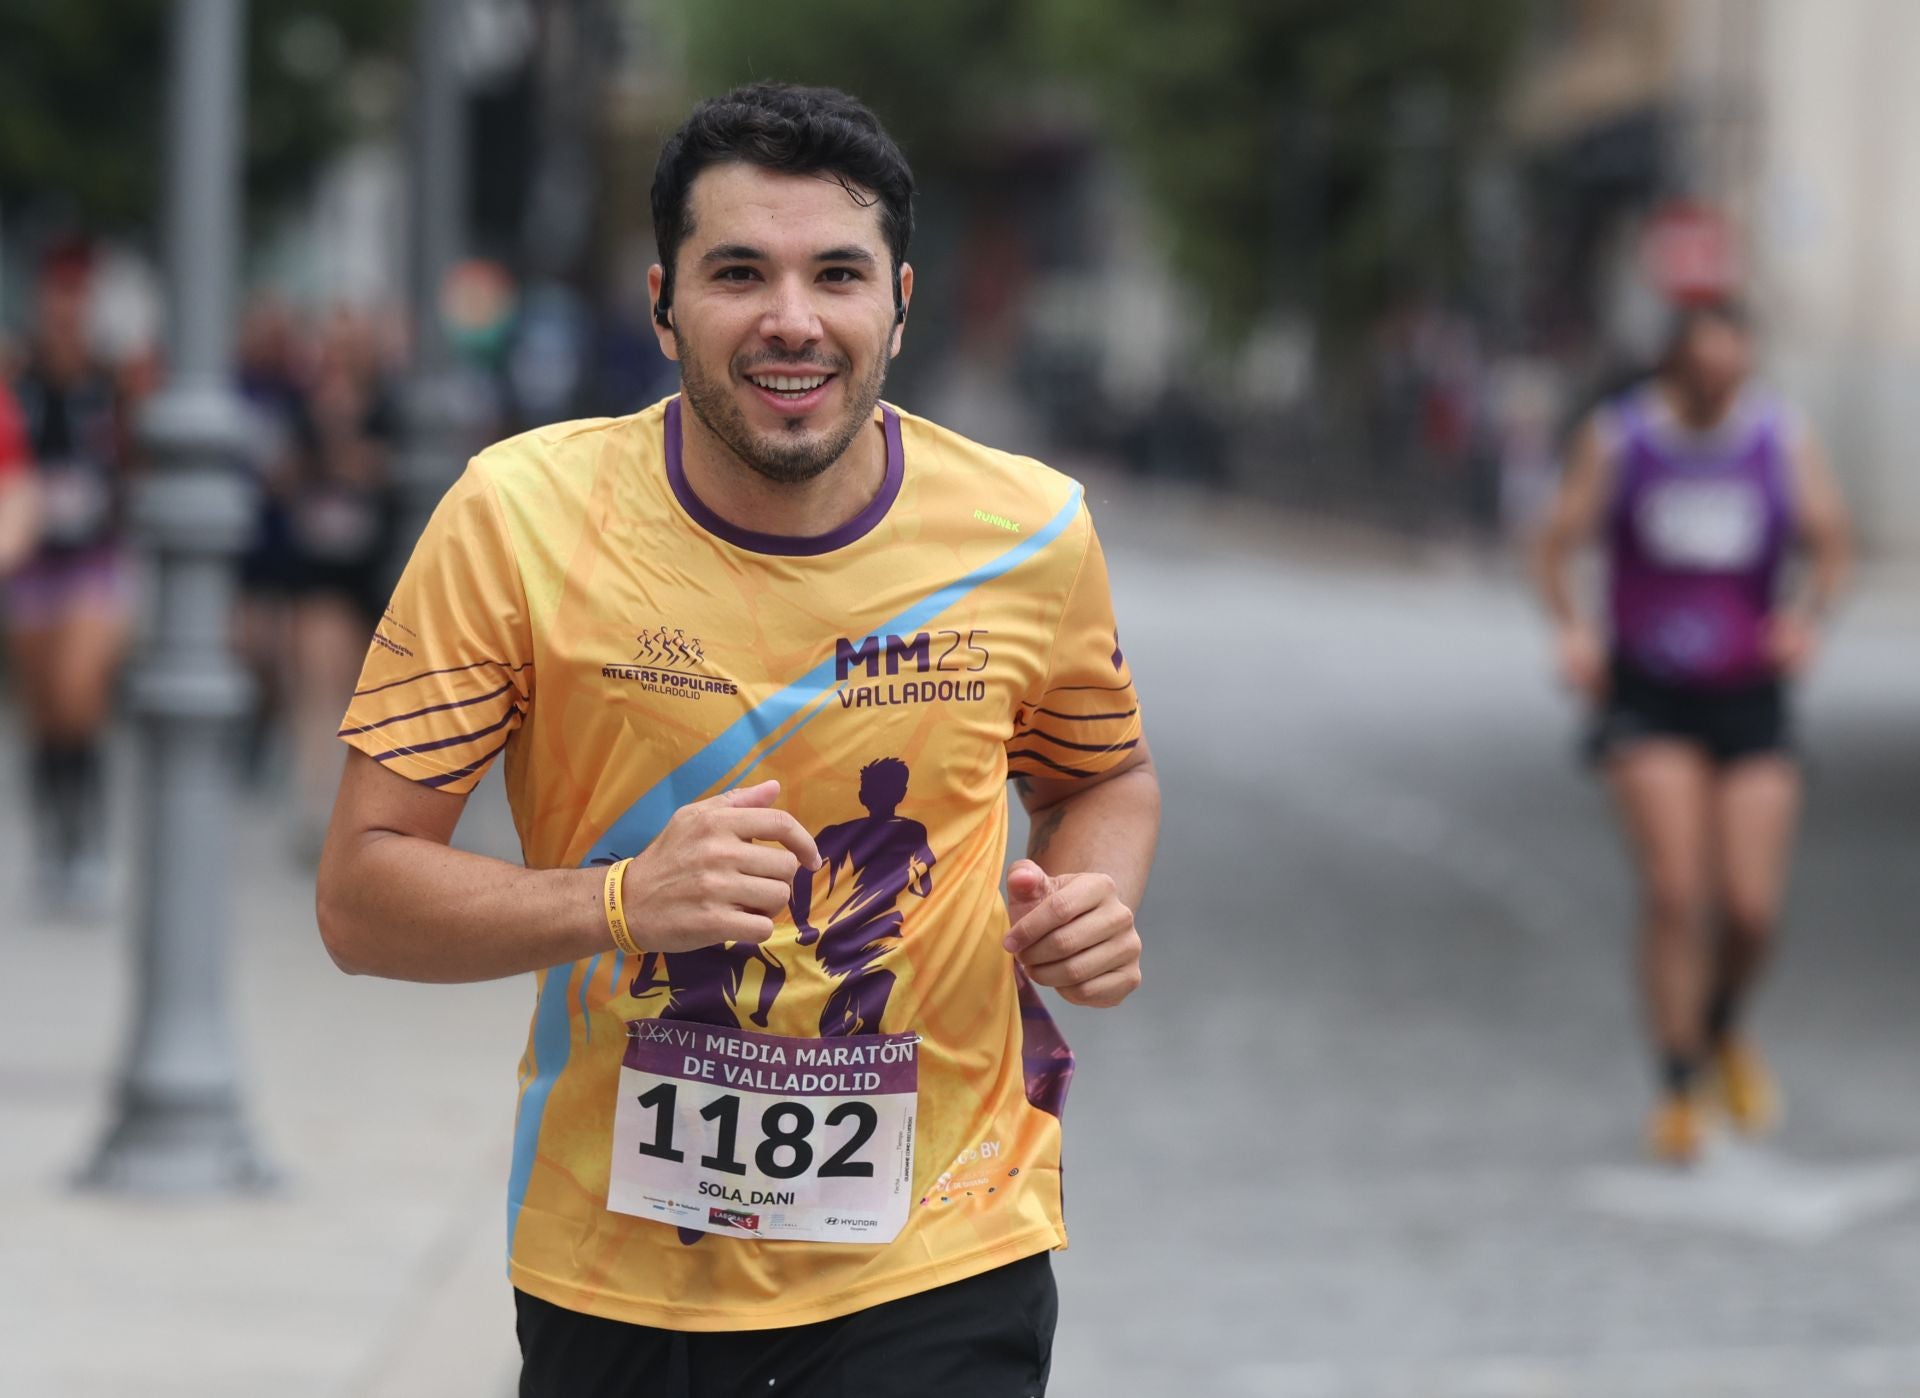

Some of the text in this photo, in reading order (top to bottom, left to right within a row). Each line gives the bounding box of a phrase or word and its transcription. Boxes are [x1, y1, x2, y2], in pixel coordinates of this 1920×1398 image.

[835, 630, 990, 681] MM25
[602, 667, 738, 695] ATLETAS POPULARES
[641, 682, 701, 700] VALLADOLID
[837, 680, 986, 709] VALLADOLID
[634, 1021, 697, 1049] XXXVI
[706, 1034, 787, 1065] MEDIA
[683, 1056, 881, 1092] DE VALLADOLID
[637, 1082, 878, 1179] 1182
[980, 1140, 1001, 1159] BY
[698, 1181, 796, 1207] SOLA_DANI
[841, 1218, 878, 1227] HYUNDAI
